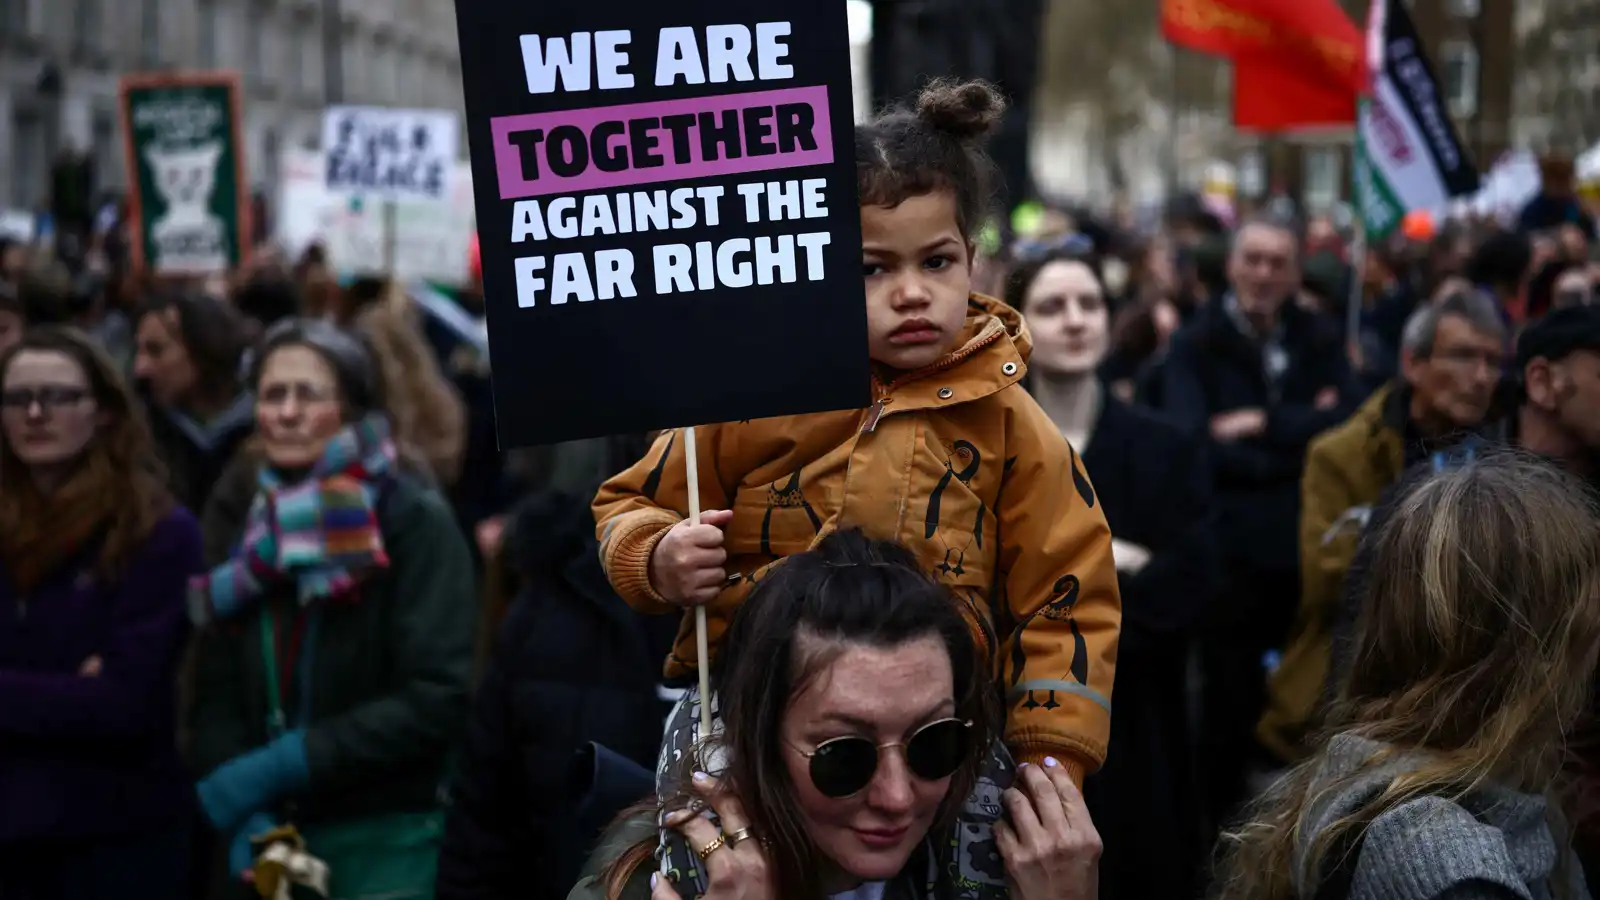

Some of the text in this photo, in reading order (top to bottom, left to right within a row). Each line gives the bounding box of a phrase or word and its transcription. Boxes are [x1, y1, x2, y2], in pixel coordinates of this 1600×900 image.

[519, 21, 794, 94] WE ARE
[507, 102, 818, 182] TOGETHER
[511, 185, 725, 243] AGAINST
[736, 177, 829, 223] THE
[514, 231, 831, 308] FAR RIGHT
